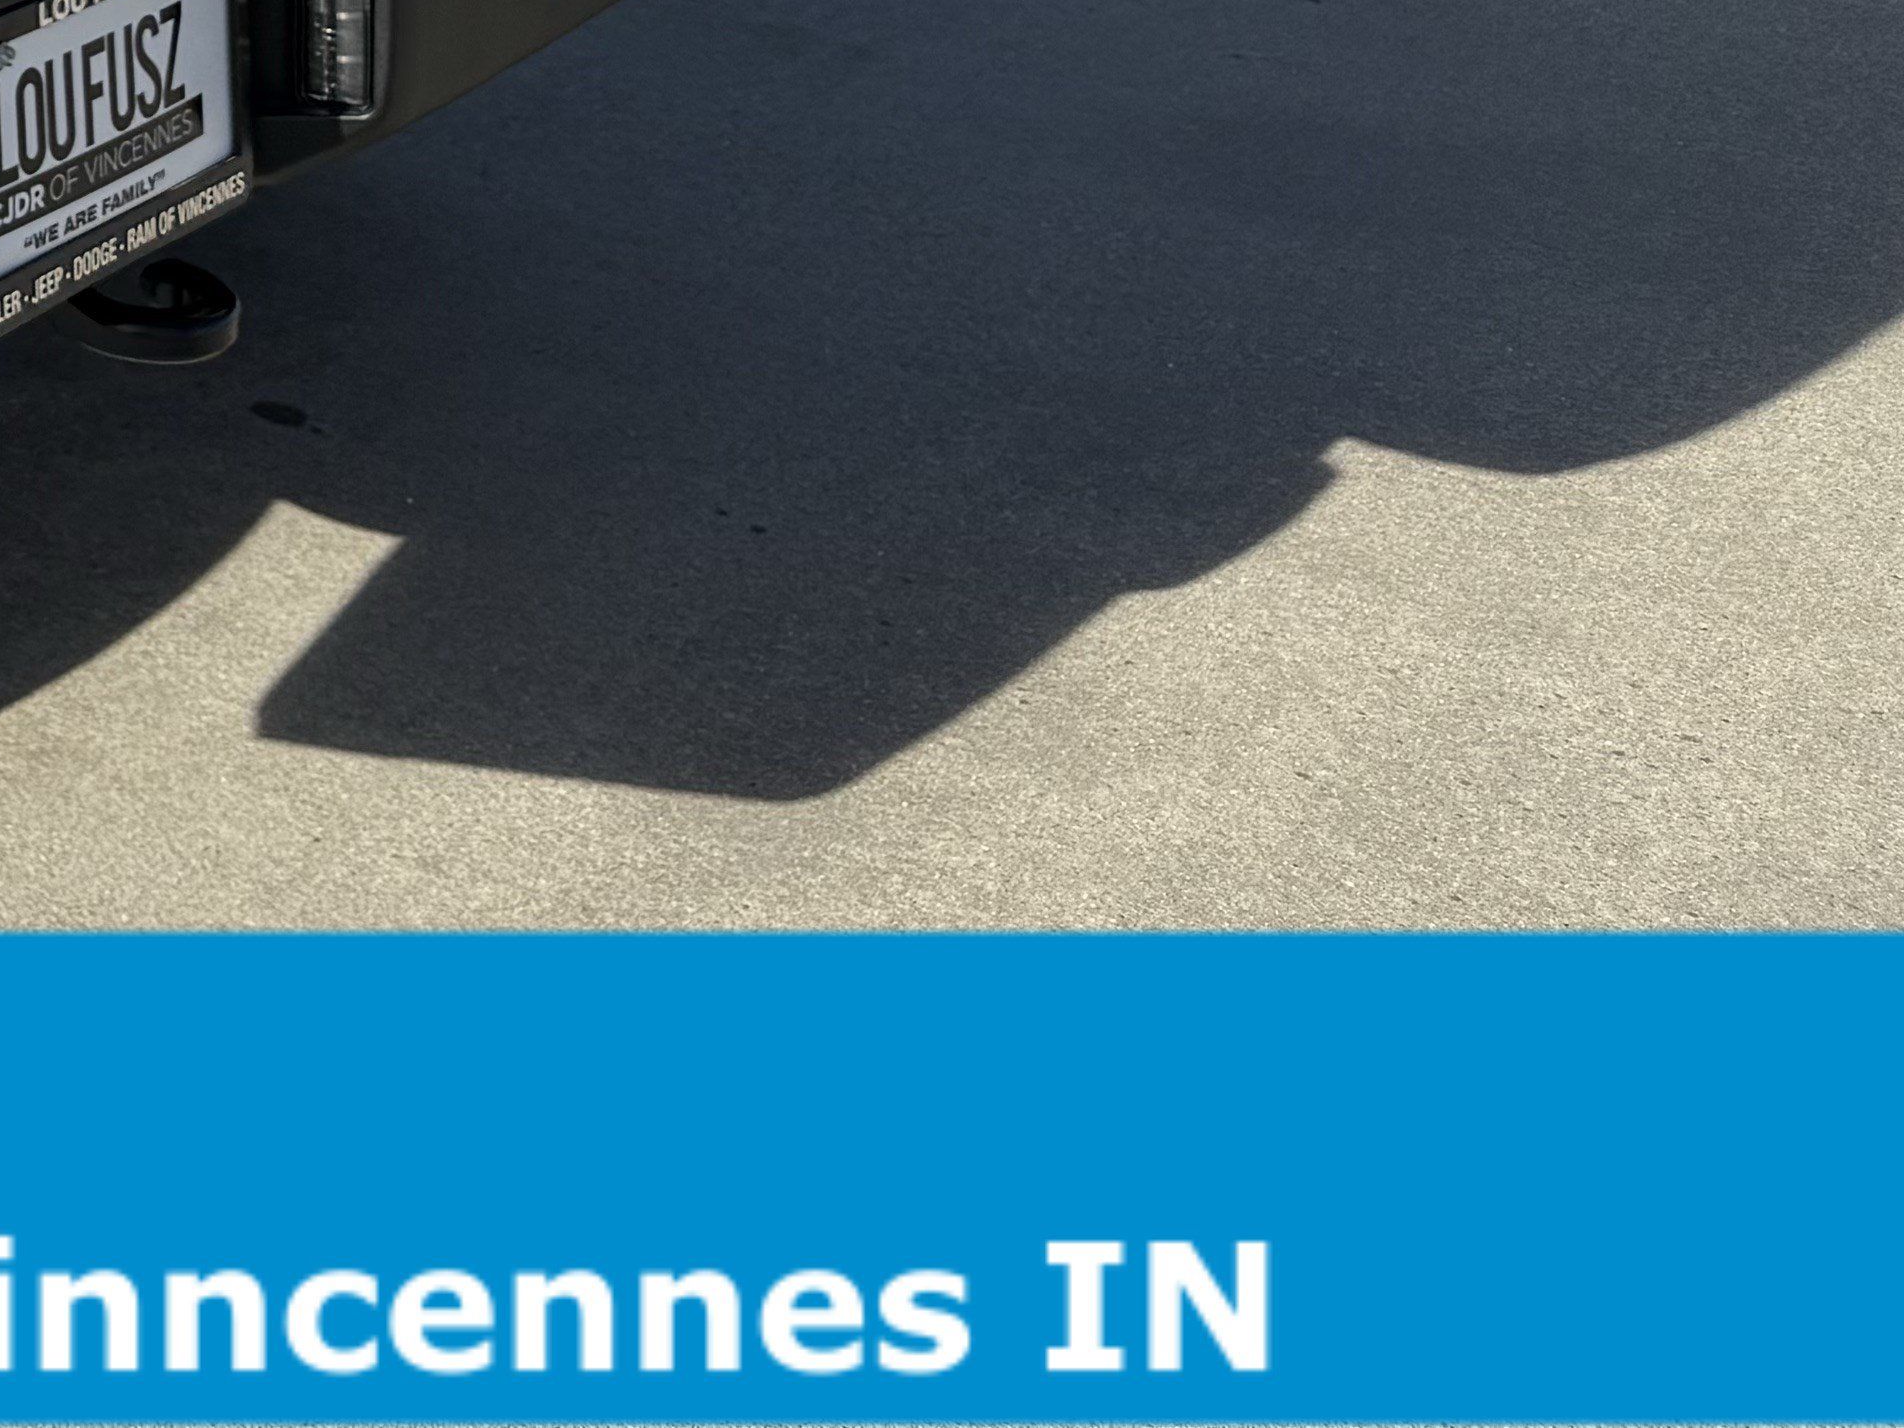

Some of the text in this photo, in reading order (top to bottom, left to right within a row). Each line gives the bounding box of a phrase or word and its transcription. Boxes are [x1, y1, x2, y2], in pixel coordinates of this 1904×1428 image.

[48, 168, 82, 202] OF
[82, 108, 194, 184] VINCENNES
[31, 265, 65, 304] JEEP
[72, 236, 119, 282] DODGE
[125, 217, 158, 253] RAM
[158, 207, 177, 236] OF
[177, 170, 247, 226] VINCENNES
[63, 203, 98, 236] ARE
